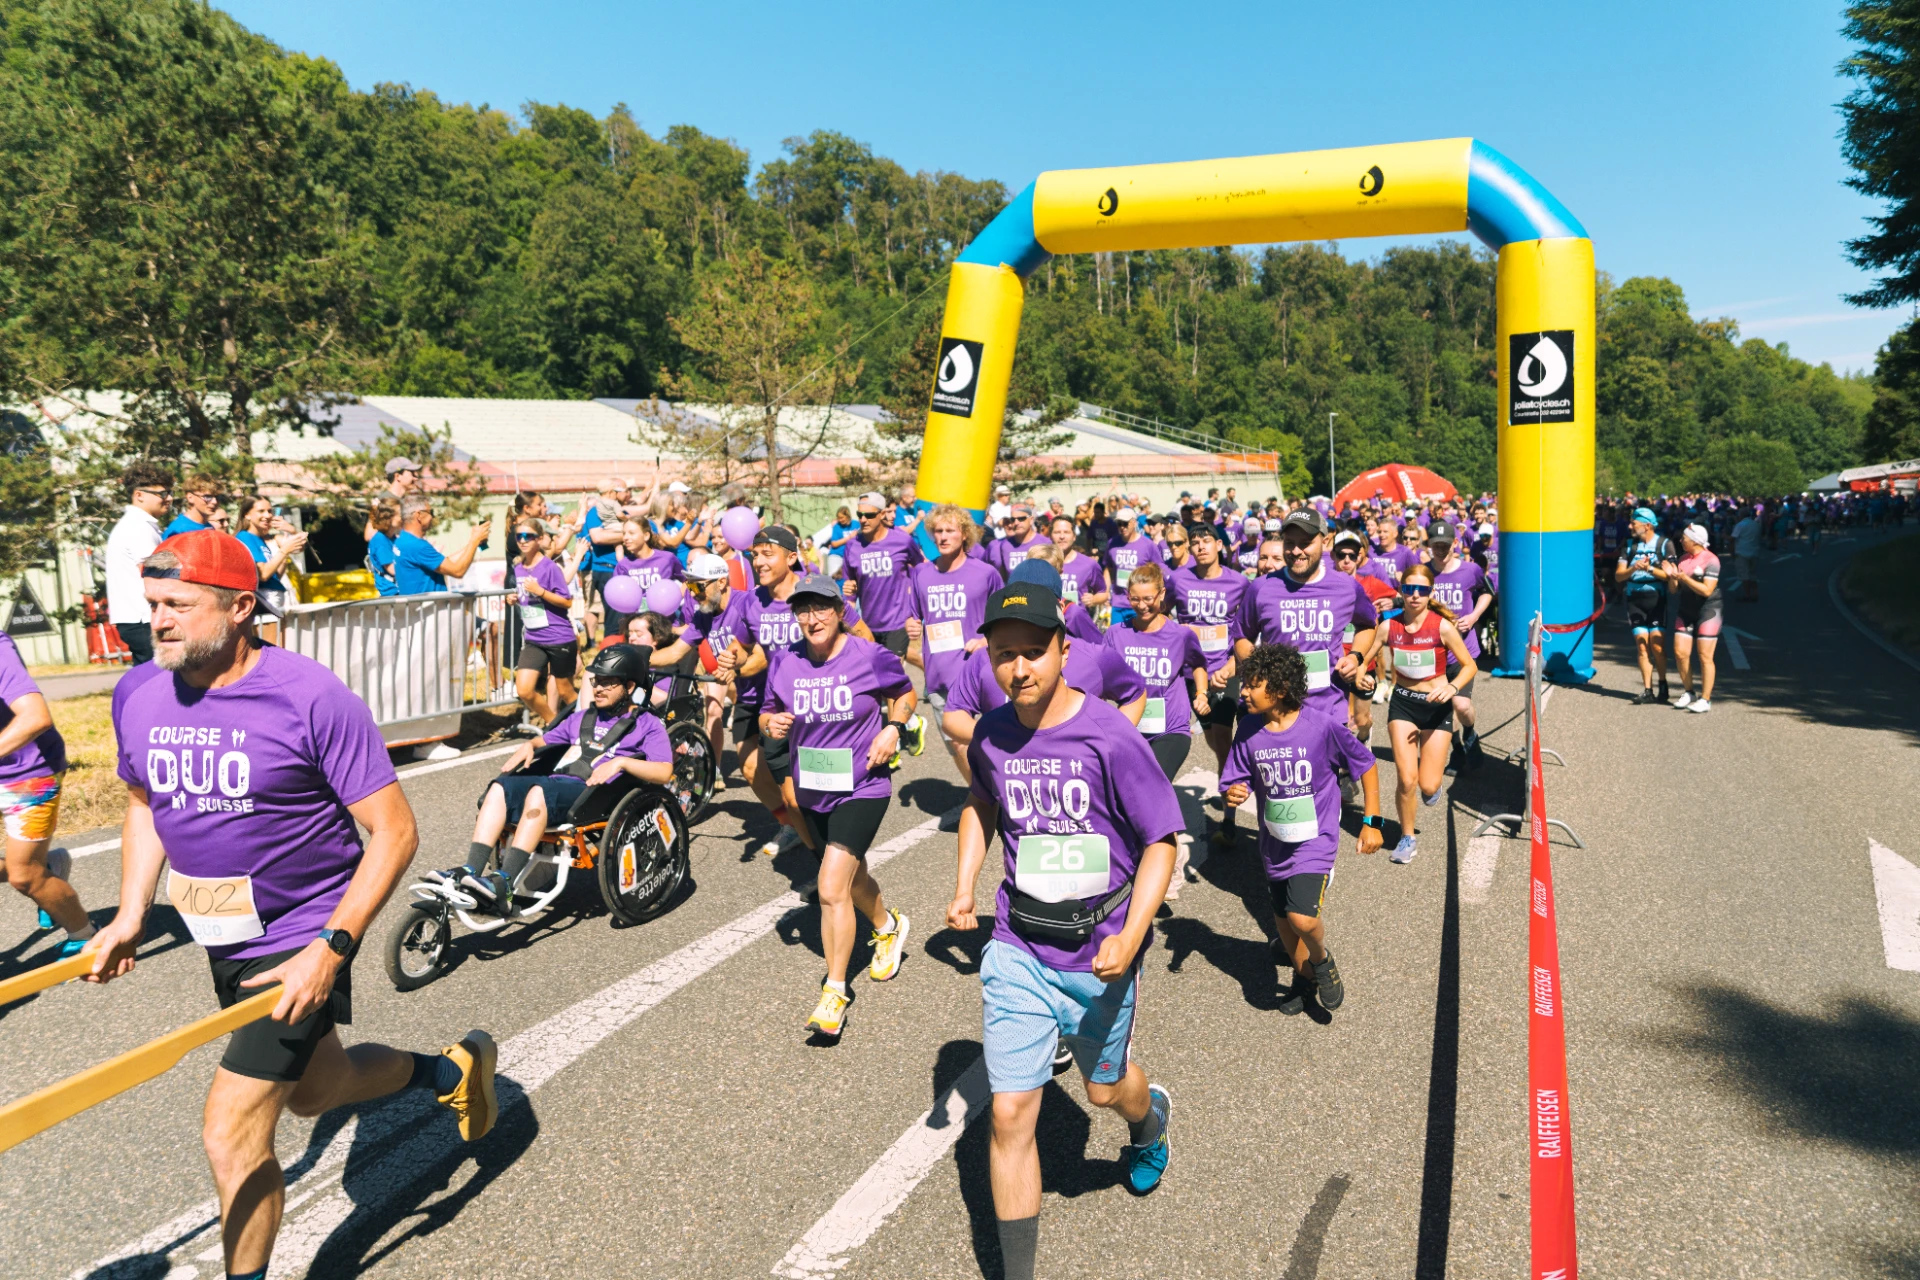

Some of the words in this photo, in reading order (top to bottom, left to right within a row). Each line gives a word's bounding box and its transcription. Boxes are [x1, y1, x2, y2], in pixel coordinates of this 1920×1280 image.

[1514, 399, 1570, 410] joliatcycles.ch
[861, 551, 881, 559] COURSE
[1116, 554, 1137, 565] DUO
[861, 557, 893, 575] DUO
[927, 584, 955, 593] COURSE
[1187, 590, 1217, 599] COURSE
[927, 592, 967, 613] DUO
[1187, 598, 1228, 618] DUO
[1280, 599, 1318, 609] COURSE
[760, 612, 791, 622] COURSE
[1280, 609, 1334, 634] DUO
[760, 622, 805, 645] DUO
[1200, 627, 1217, 641] 116
[1305, 633, 1332, 642] SUISSE
[1125, 646, 1158, 656] COURSE
[1406, 652, 1422, 666] 19
[1125, 656, 1172, 679] DUO
[793, 676, 834, 688] COURSE
[1145, 678, 1169, 686] SUISSE
[793, 685, 853, 716] DUO
[820, 711, 855, 723] SUISSE
[149, 726, 222, 746] COURSE
[804, 750, 834, 771] 234
[1254, 747, 1293, 761] COURSE
[147, 749, 250, 798] DUO
[1004, 758, 1062, 775] COURSE
[1256, 759, 1313, 787] DUO
[197, 797, 255, 813] SUISSE
[1005, 778, 1090, 821] DUO
[1272, 803, 1298, 821] 26
[1047, 819, 1095, 834] SUISSE
[1040, 839, 1085, 871] 26
[638, 858, 676, 900] Joelette
[182, 882, 242, 915] 102
[1533, 877, 1548, 919] RAIFFEISEN
[1534, 965, 1554, 1017] RAIFFEISEN
[1536, 1089, 1561, 1159] RAIFFEISEN
